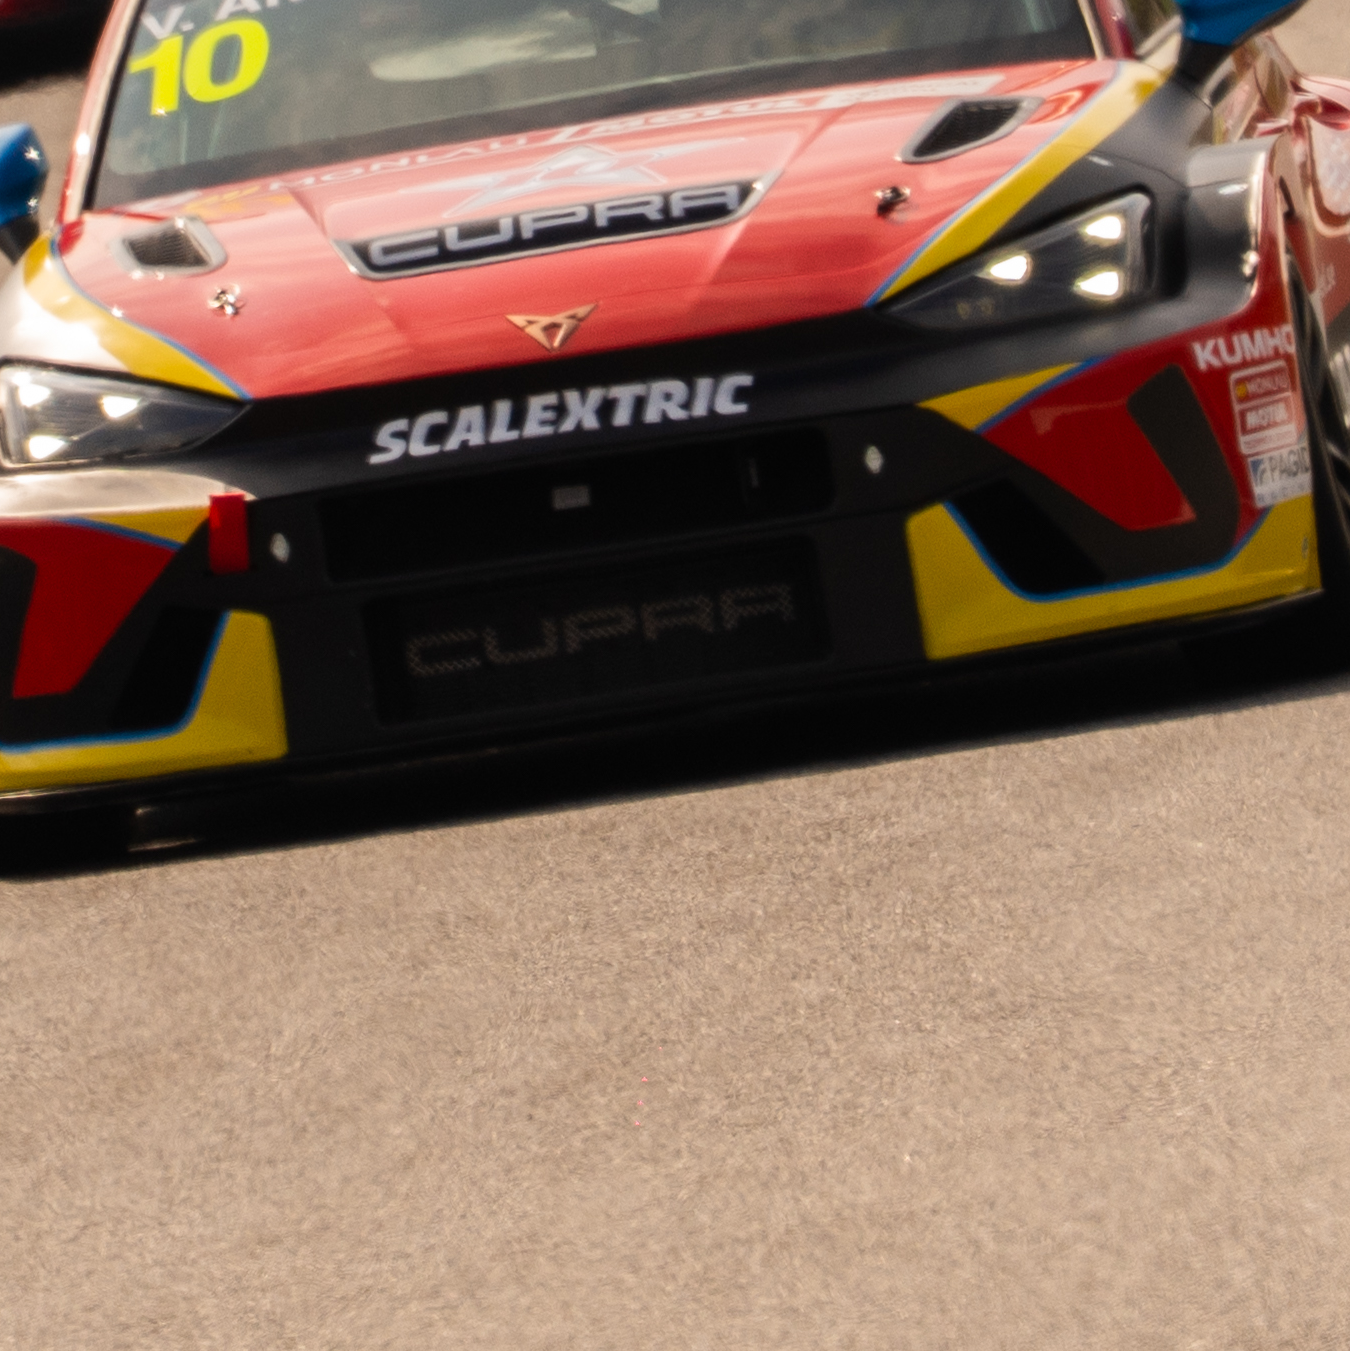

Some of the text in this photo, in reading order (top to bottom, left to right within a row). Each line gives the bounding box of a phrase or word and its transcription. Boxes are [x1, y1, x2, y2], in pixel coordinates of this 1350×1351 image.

[128, 18, 270, 117] 10
[142, 3, 194, 40] V.
[368, 185, 740, 268] CUPRA
[367, 373, 755, 465] SCALEXTRIC
[405, 583, 798, 679] CUPRA
